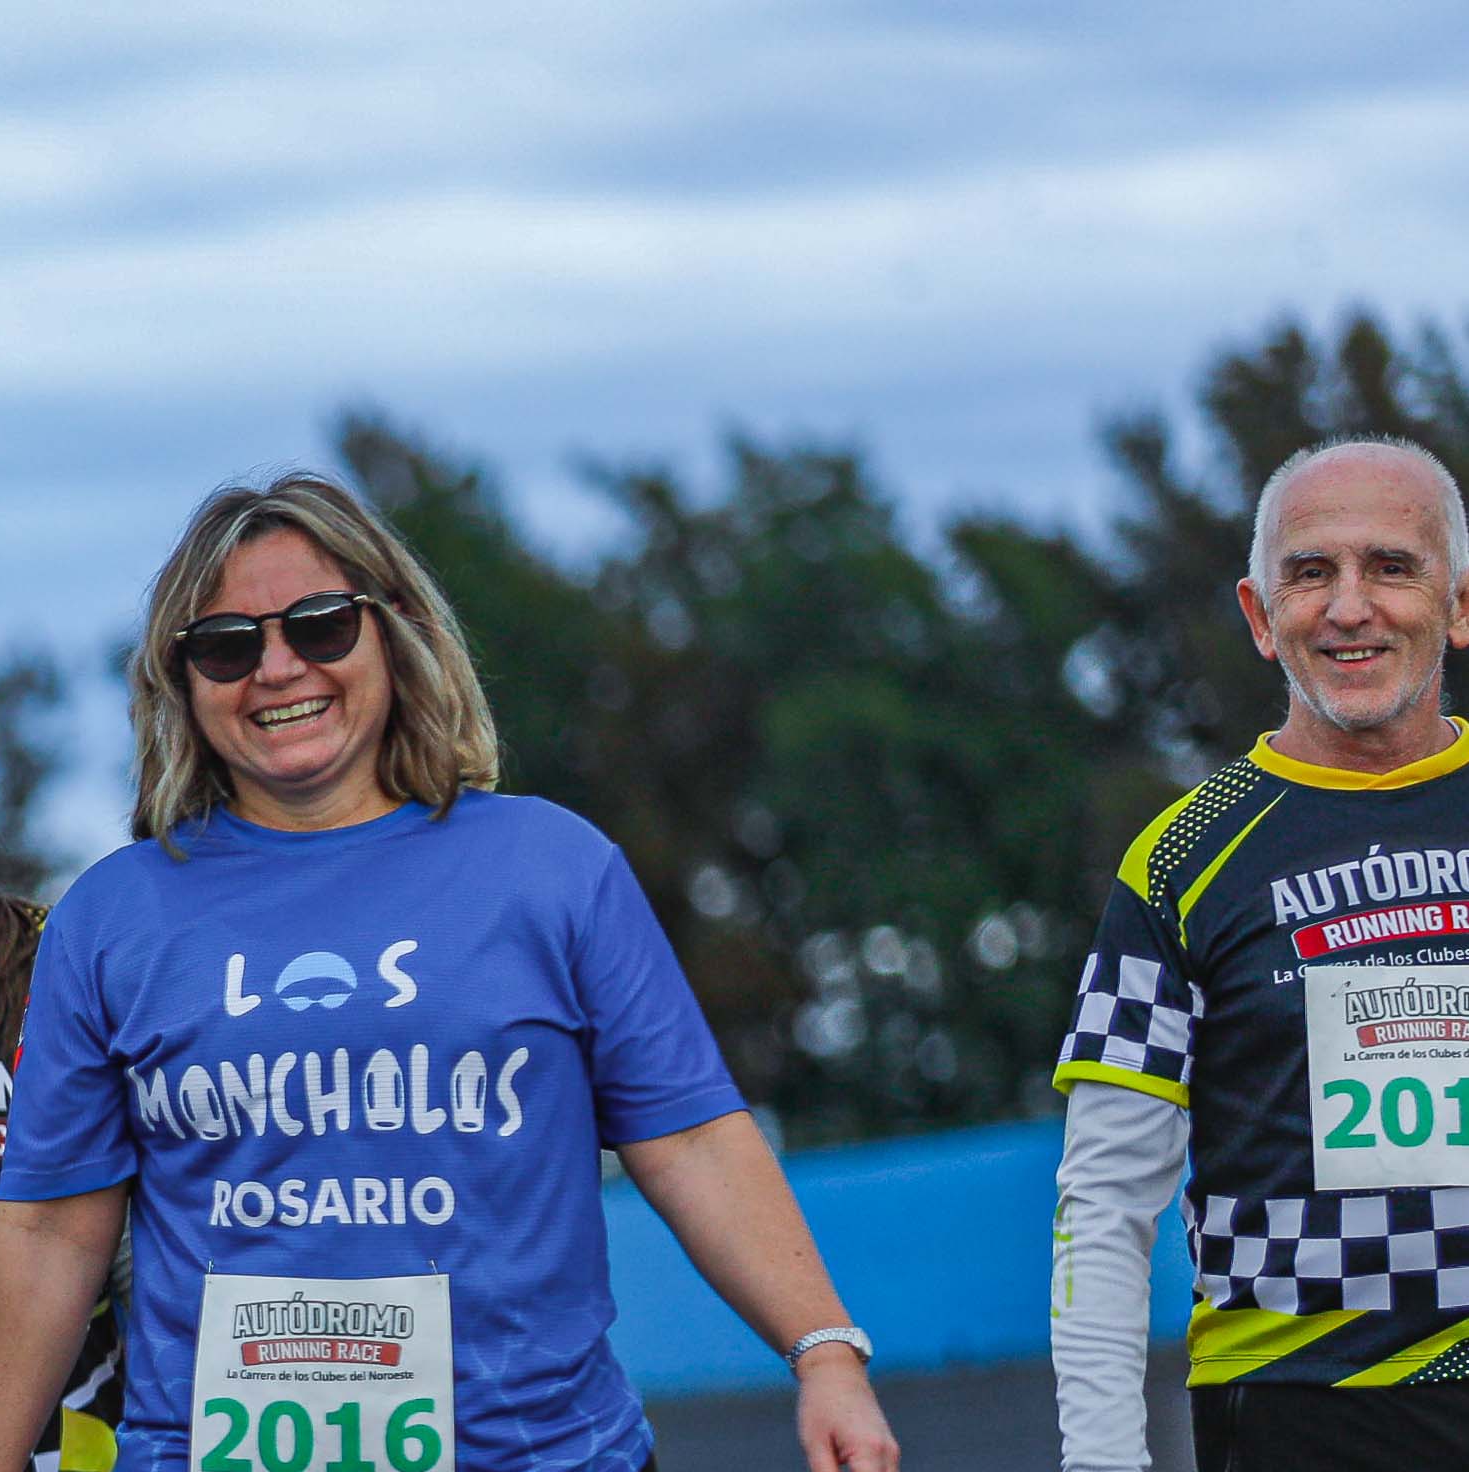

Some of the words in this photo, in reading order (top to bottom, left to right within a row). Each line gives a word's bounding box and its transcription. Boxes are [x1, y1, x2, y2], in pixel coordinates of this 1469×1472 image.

[1322, 906, 1443, 949] RUNNING
[1273, 970, 1293, 985] La
[1389, 952, 1413, 966] los
[1416, 947, 1469, 964] Clubes
[1374, 1021, 1446, 1045] RUNNING
[1344, 1052, 1356, 1061] La
[1358, 1051, 1395, 1061] Carrera
[1397, 1049, 1410, 1059] de
[1412, 1049, 1427, 1059] los
[1429, 1048, 1461, 1058] Clubes
[128, 1043, 530, 1141] MONCHOLOS
[209, 1176, 456, 1228] ROSARIO
[232, 1291, 415, 1340] AUTÓDROMO
[258, 1340, 332, 1363] RUNNING
[337, 1342, 383, 1363] RACE
[227, 1368, 238, 1380] La
[240, 1370, 277, 1381] Carrera
[278, 1370, 292, 1381] de
[294, 1371, 310, 1382] los
[312, 1370, 348, 1382] Clubes
[349, 1370, 367, 1381] del
[368, 1371, 415, 1382] Noroeste
